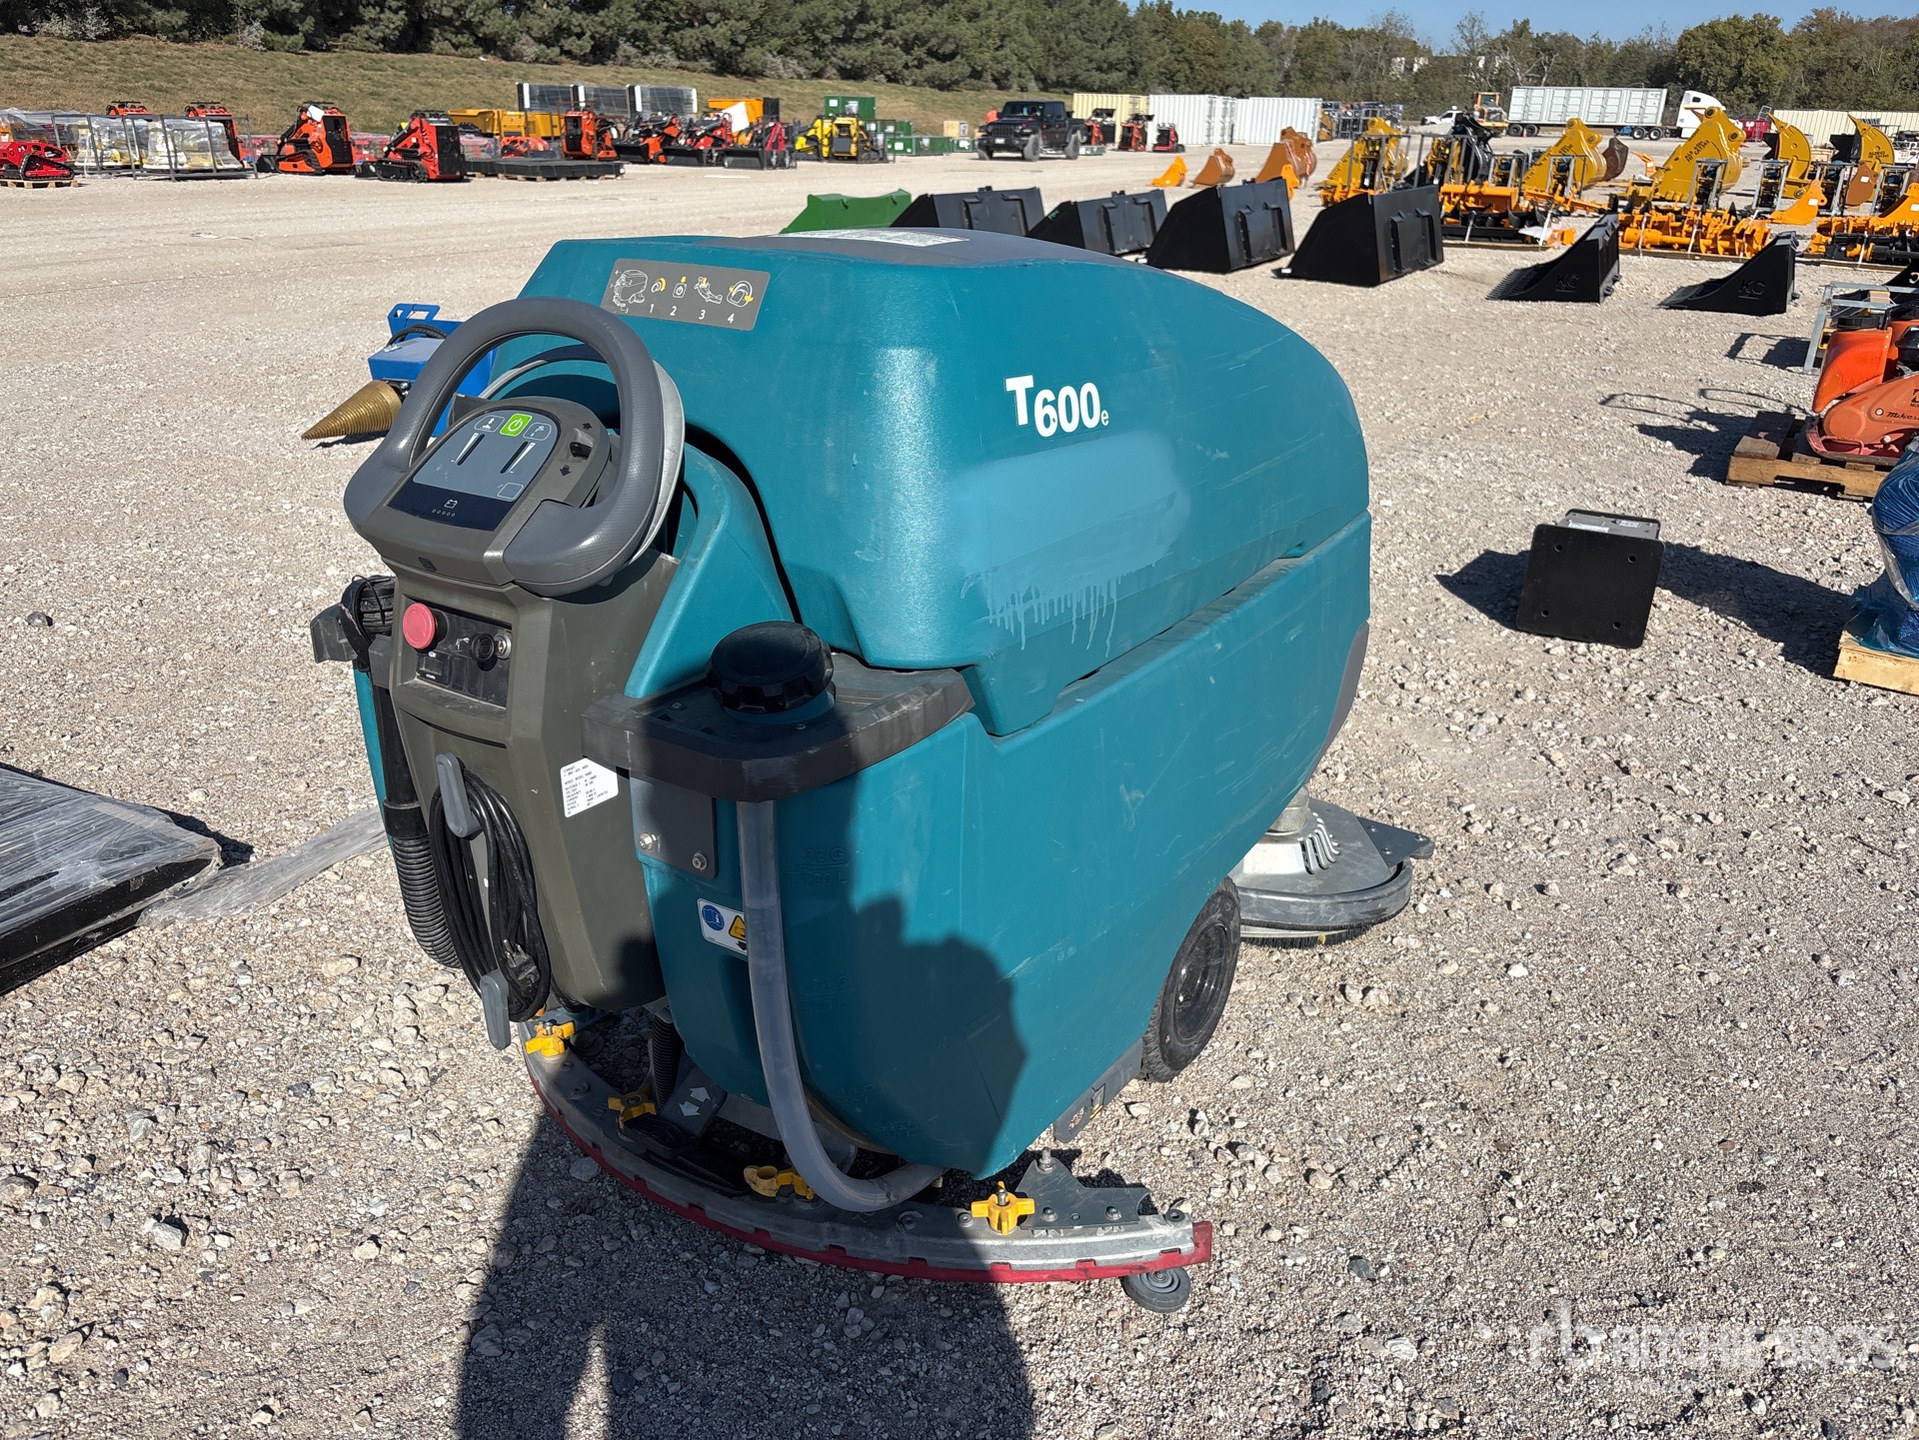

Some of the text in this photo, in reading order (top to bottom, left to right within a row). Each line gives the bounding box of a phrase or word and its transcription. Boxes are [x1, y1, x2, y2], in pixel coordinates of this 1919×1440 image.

[1738, 279, 1766, 296] KC
[648, 304, 735, 323] 1 2 3 4
